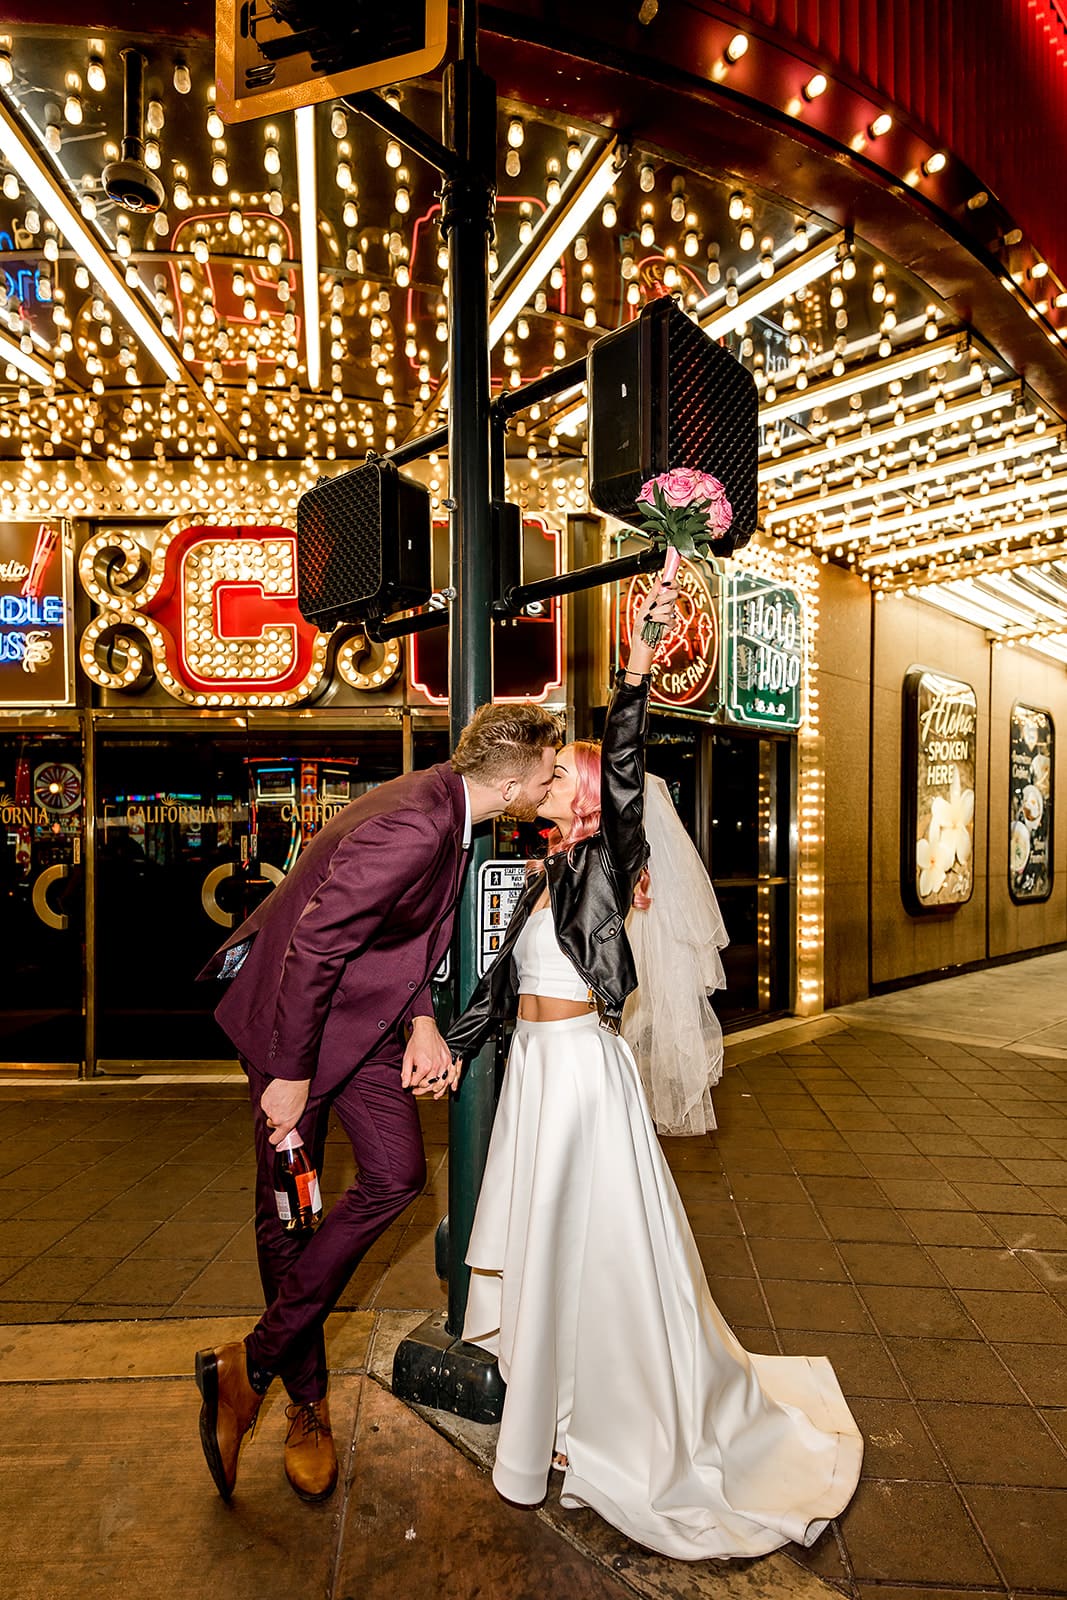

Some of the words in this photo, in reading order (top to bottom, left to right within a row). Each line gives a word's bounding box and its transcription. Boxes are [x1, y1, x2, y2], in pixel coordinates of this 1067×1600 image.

[749, 595, 796, 650] HOLO
[662, 655, 708, 694] CREAM
[758, 646, 799, 691] HOLO
[928, 741, 968, 761] SPOKEN
[926, 764, 954, 785] HERE
[0, 806, 50, 826] ORNIA
[127, 805, 217, 824] CALIFORNIA
